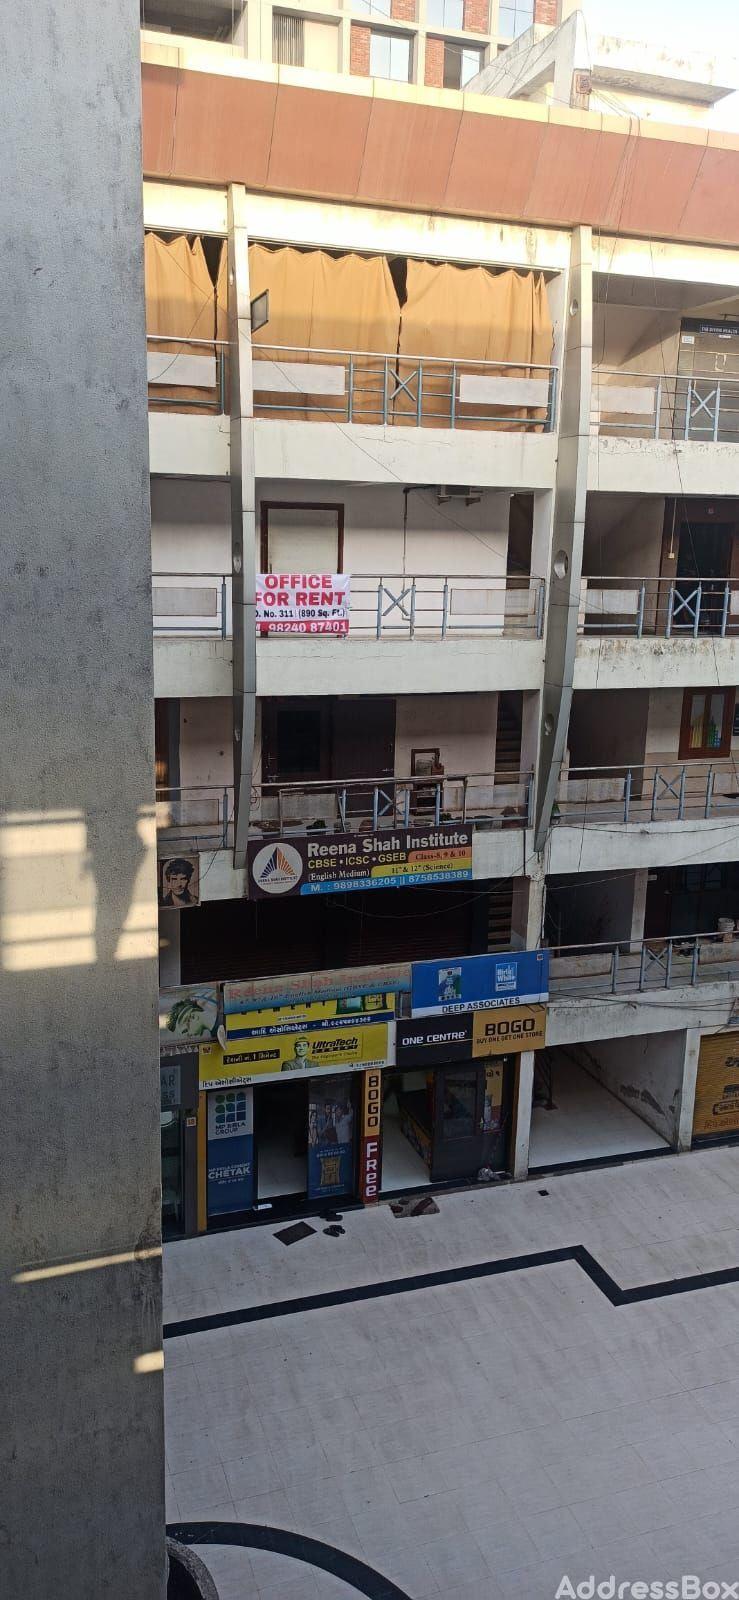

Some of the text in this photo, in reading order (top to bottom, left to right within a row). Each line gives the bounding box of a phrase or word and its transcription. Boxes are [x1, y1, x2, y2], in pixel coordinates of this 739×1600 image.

[264, 574, 333, 589] OFFICE
[295, 592, 346, 606] RENT
[263, 609, 277, 618] No.
[280, 610, 294, 618] 311
[298, 609, 316, 618] (890
[317, 608, 330, 619] Sq.
[269, 623, 306, 633] 98240
[310, 621, 348, 632] 87401
[307, 832, 469, 857] Reena Shah Institute
[458, 849, 467, 857] 10
[308, 852, 406, 869] CBSE ICSC GSEB
[423, 862, 454, 873] (Science)
[308, 868, 370, 882] (English Medium)
[442, 1004, 465, 1014] DEEP
[467, 996, 520, 1011] ASSOCIATES
[485, 1018, 536, 1036] BOGO
[525, 1030, 543, 1038] STORE
[312, 1036, 359, 1050] UltraTech
[367, 1075, 379, 1128] BOGO
[207, 1166, 251, 1179] CHETAK
